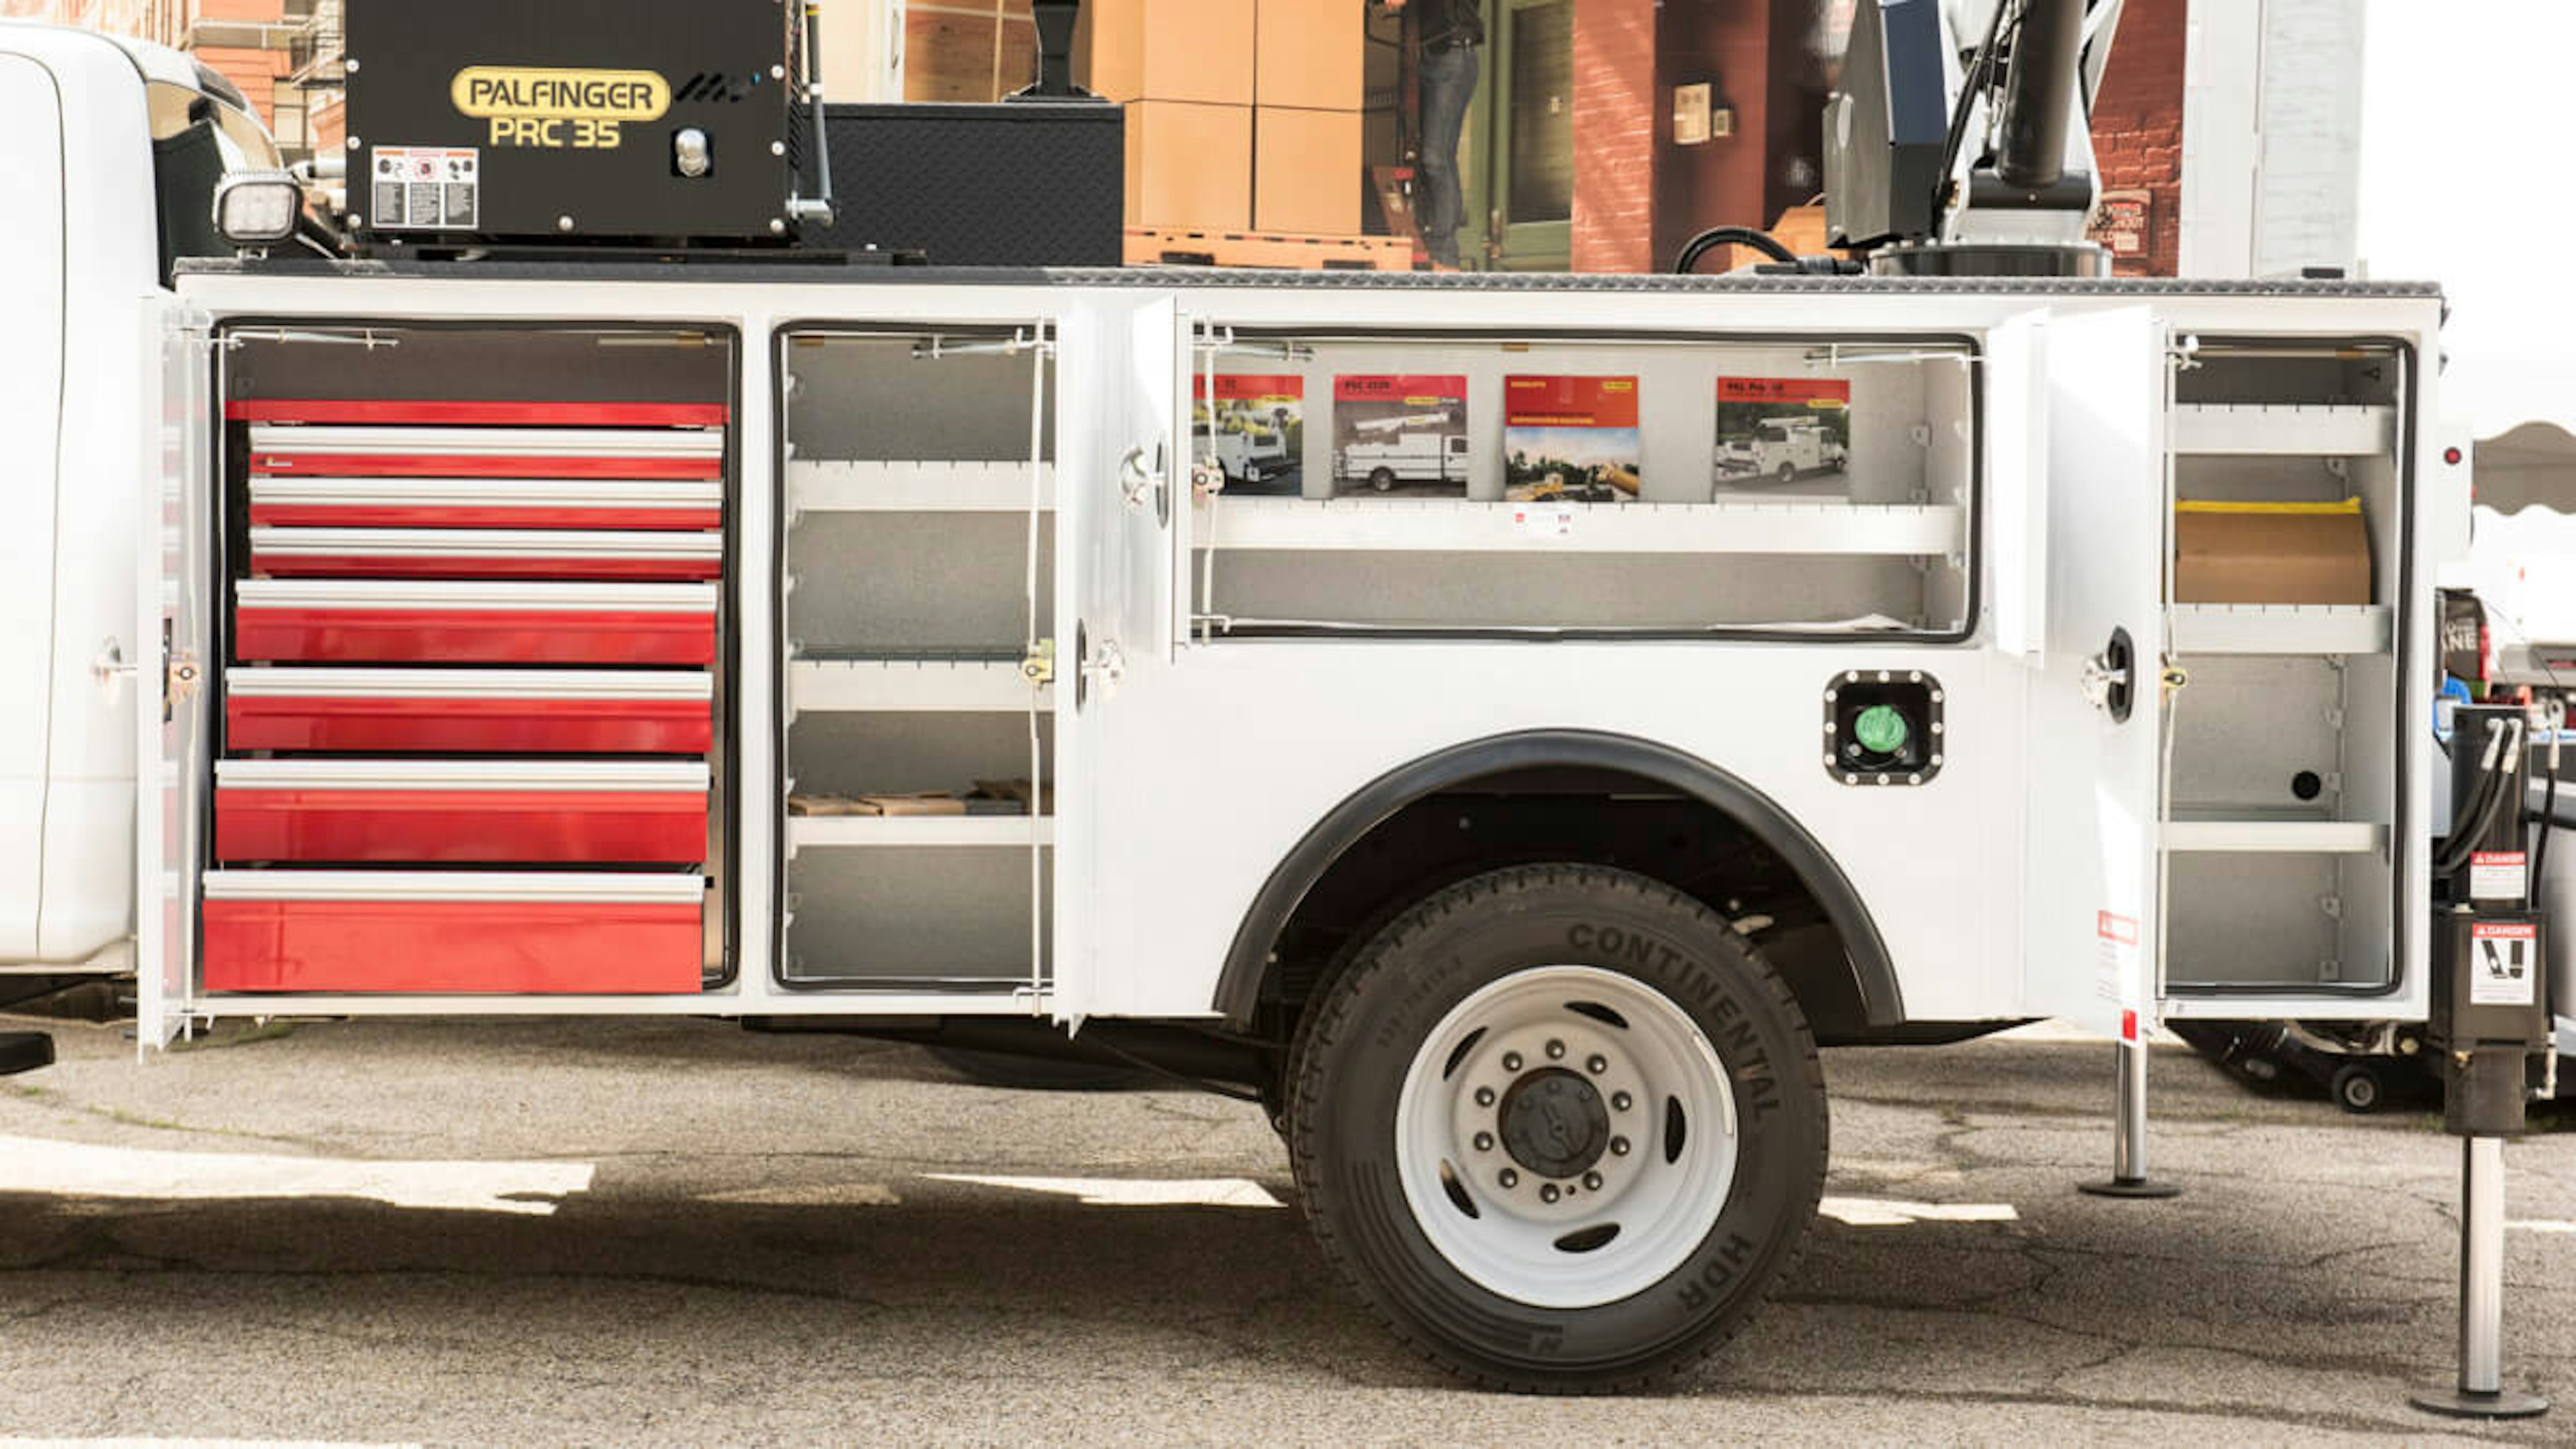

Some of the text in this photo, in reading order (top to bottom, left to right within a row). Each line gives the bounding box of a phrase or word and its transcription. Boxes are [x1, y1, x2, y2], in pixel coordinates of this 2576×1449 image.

[470, 79, 653, 110] PALFINGER
[490, 117, 621, 148] PRC 35
[2487, 853, 2525, 864] DANGER
[2487, 926, 2533, 936] DANGER
[1568, 923, 1781, 1122] CONTINENTAL
[1677, 1232, 1753, 1313] HDR
